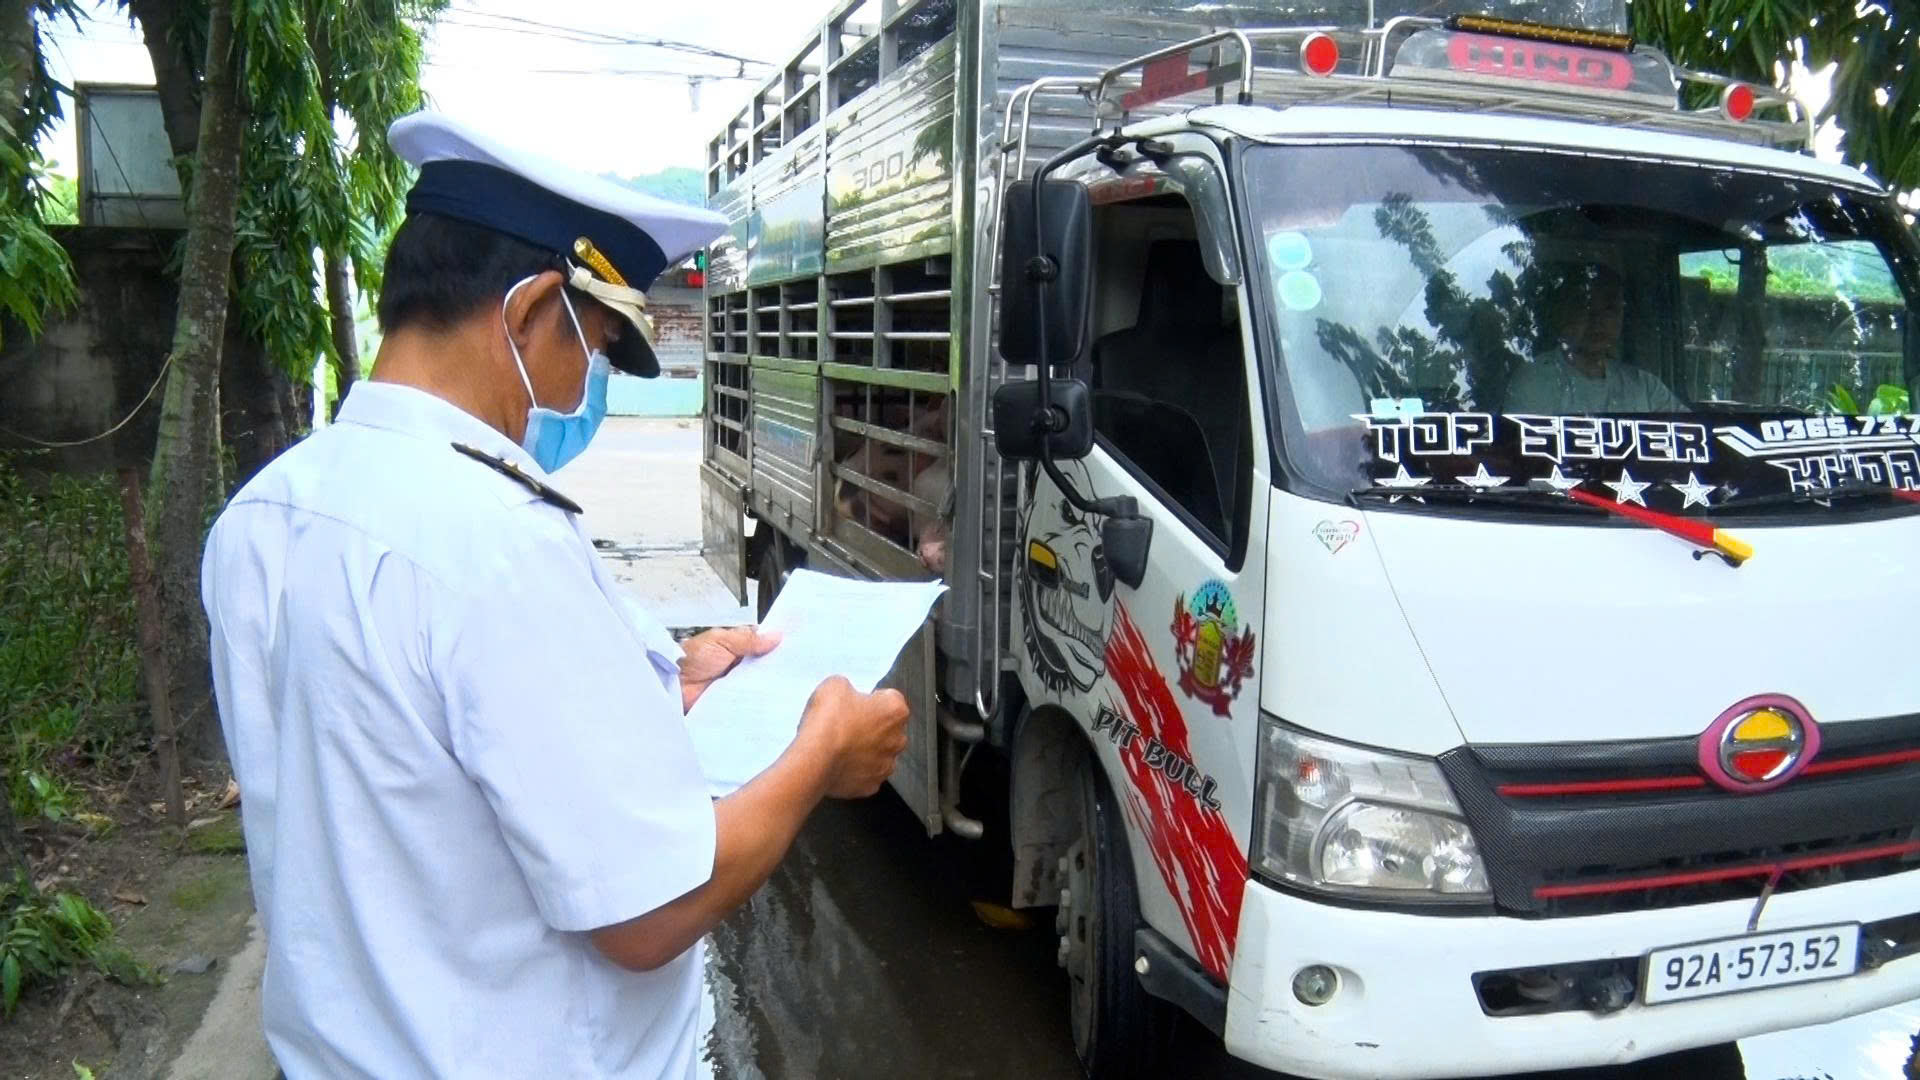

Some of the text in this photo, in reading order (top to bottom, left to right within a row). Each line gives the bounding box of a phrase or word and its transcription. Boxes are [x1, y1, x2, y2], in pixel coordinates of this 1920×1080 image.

[1466, 44, 1614, 82] HINO
[852, 151, 904, 192] 300
[1349, 411, 1710, 464] TOP SEVER
[1092, 703, 1222, 811] PIT BULL
